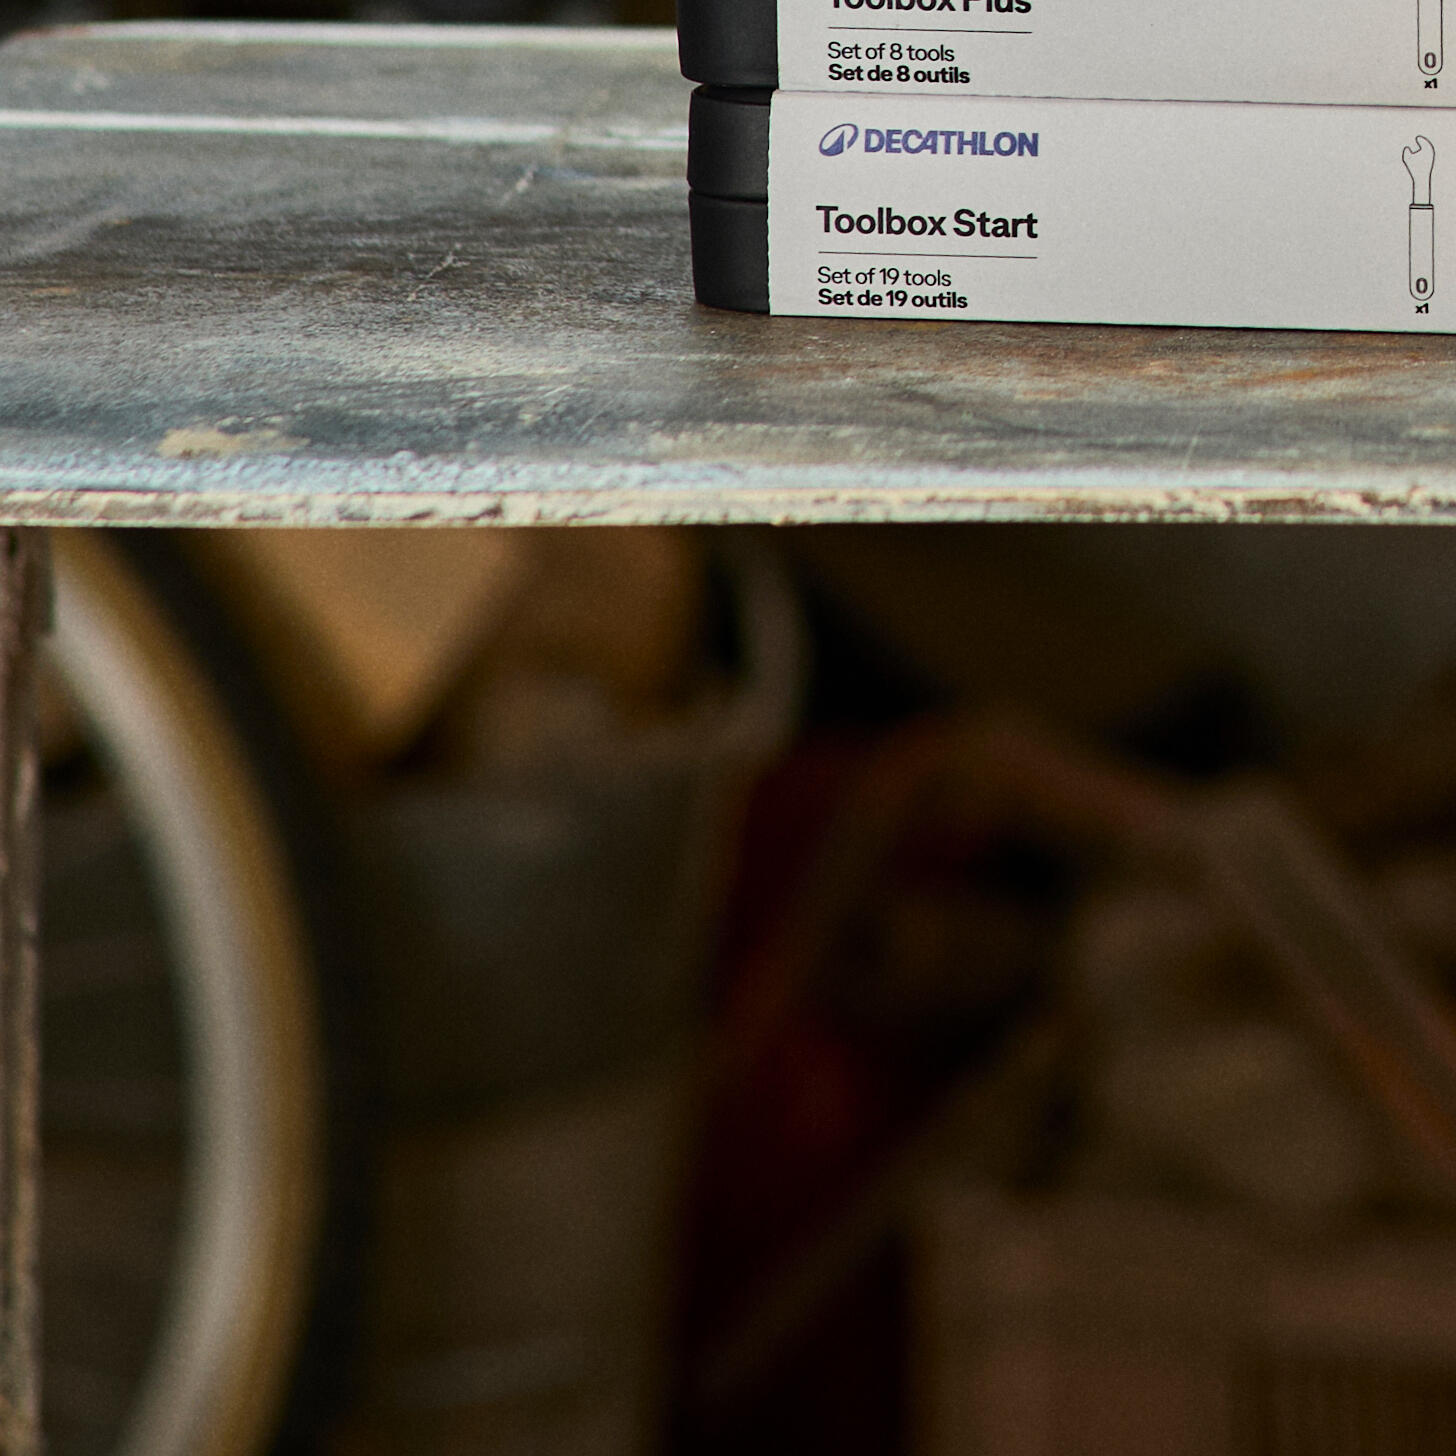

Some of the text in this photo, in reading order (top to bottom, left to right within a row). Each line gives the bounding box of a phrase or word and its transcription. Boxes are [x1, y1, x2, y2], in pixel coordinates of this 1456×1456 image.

[827, 41, 956, 62] Set of 8 tools
[828, 63, 971, 84] Set de 8 outils
[1424, 77, 1438, 89] x1
[864, 128, 1039, 157] DECATHLON
[815, 205, 1039, 239] Toolbox Start
[817, 265, 952, 287] Set of 19 tools
[818, 287, 969, 309] Set de 19 outils
[1415, 302, 1430, 314] x1
